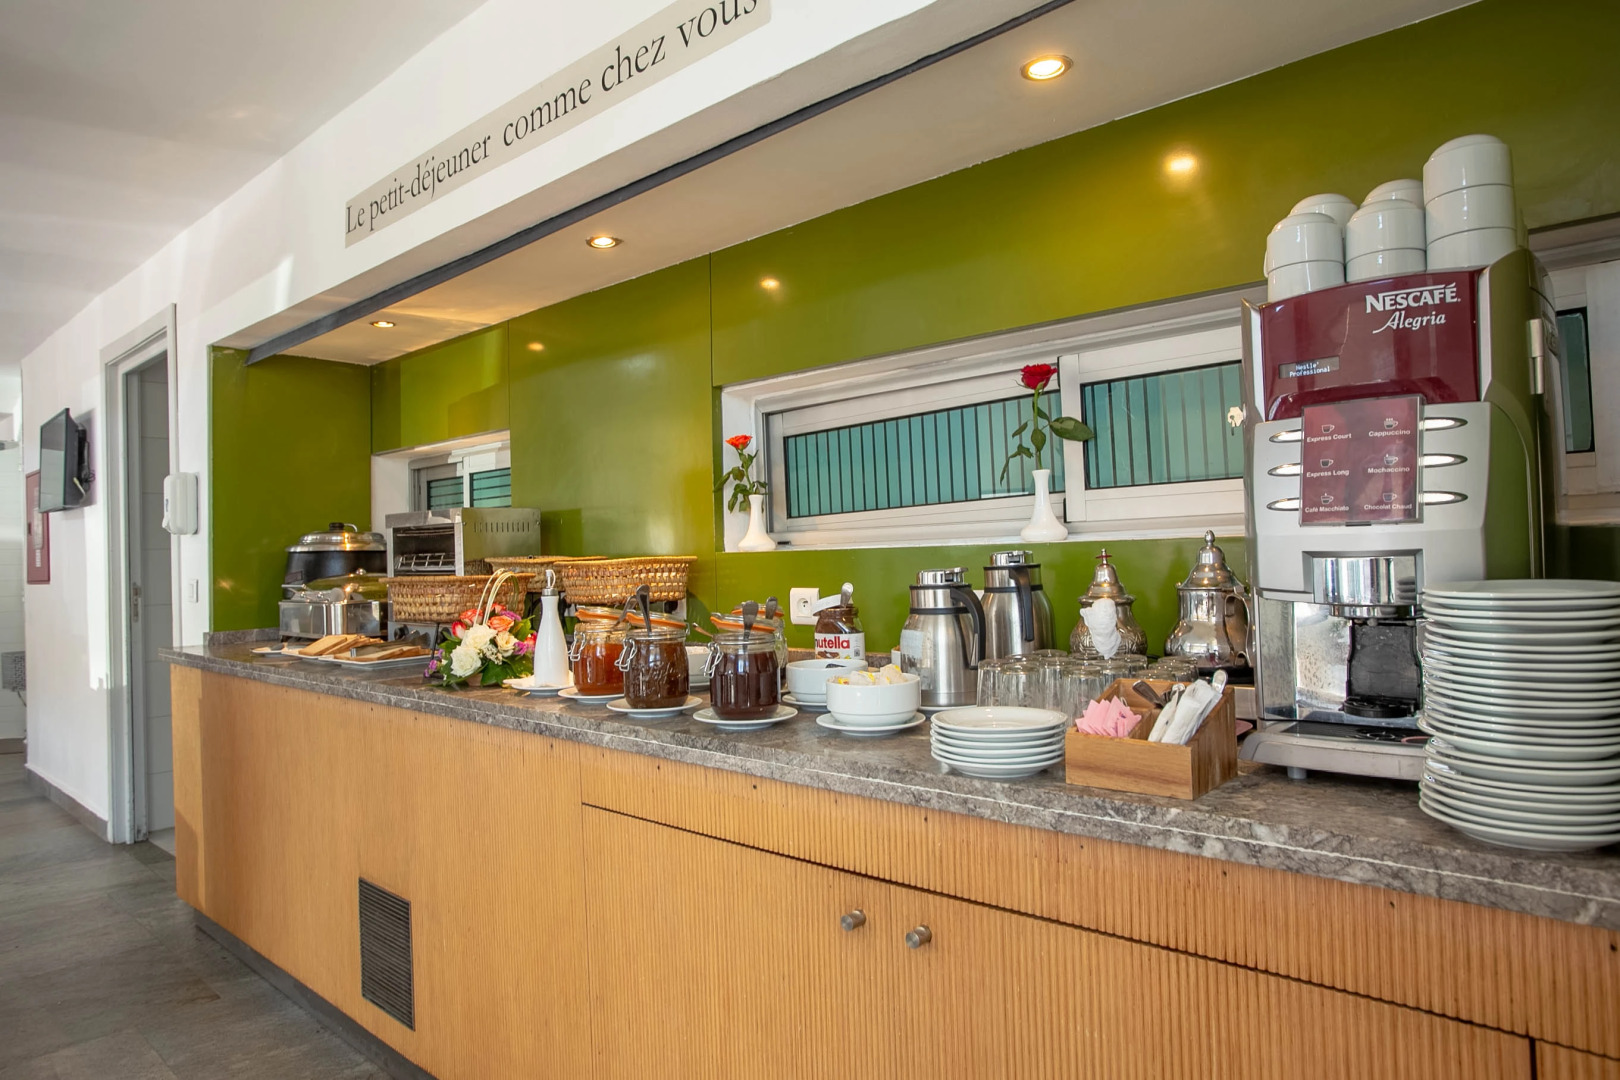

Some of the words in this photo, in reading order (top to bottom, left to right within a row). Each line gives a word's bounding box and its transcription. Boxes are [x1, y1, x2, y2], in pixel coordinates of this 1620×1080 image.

[345, 205, 365, 235] Le
[369, 135, 491, 232] petit-déjeuner
[503, 78, 592, 147] comme
[601, 35, 666, 92] chez
[1365, 282, 1458, 314] NESCAFÉ
[1372, 310, 1447, 335] Alegria
[1289, 365, 1331, 378] Professional
[1368, 429, 1411, 437] Cappuccino
[1306, 435, 1332, 443] Express
[1306, 470, 1332, 478] Express
[1332, 469, 1350, 477] Long
[1367, 466, 1411, 474] Mochaccino
